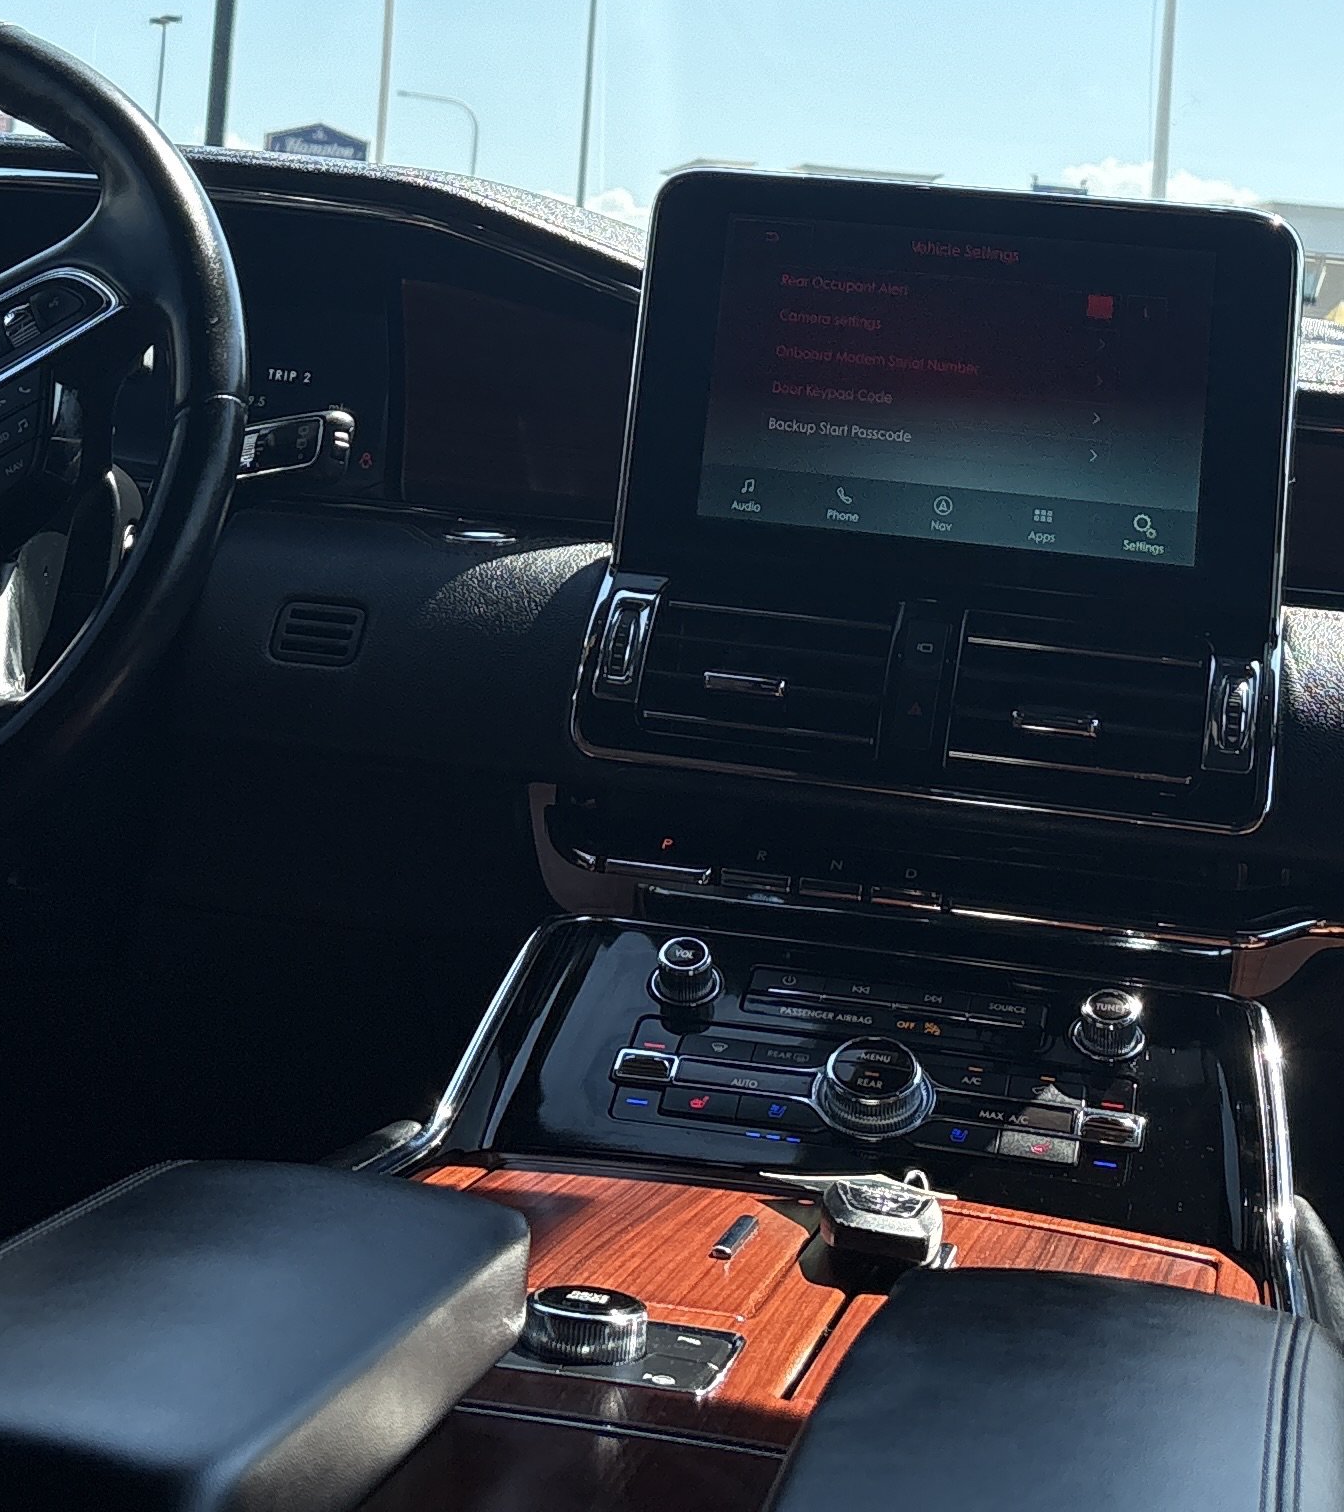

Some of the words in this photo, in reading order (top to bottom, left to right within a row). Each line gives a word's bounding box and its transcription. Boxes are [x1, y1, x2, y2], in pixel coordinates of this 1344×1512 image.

[811, 275, 876, 294] Occupant
[779, 308, 832, 325] Camera
[268, 368, 298, 382] TRIP
[303, 372, 312, 383] 2
[772, 381, 804, 396] Door
[806, 385, 854, 403] Keypad
[858, 389, 893, 404] Code
[768, 417, 816, 435] Backup
[819, 422, 848, 437] Start
[851, 425, 912, 443] Passcode
[6, 459, 24, 475] NAV
[731, 499, 761, 513] Audio
[826, 508, 860, 523] Phone
[930, 519, 953, 532] Nav
[1027, 530, 1056, 545] Apps
[1122, 539, 1165, 556] Settings
[660, 837, 674, 851] P
[756, 850, 768, 862] R
[829, 858, 844, 872] N
[905, 868, 917, 879] D
[675, 946, 695, 960] VOL
[988, 1002, 1027, 1015] SOURCE
[780, 1007, 834, 1021] PASSENGER
[836, 1013, 873, 1026] AIRBAG
[896, 1019, 917, 1031] OFF
[767, 1049, 792, 1060] REAR
[860, 1051, 892, 1064] MENU
[731, 1078, 758, 1089] AUTO
[857, 1077, 883, 1089] REAR
[961, 1076, 982, 1086] A/C
[979, 1109, 1004, 1121] MAX
[1008, 1114, 1029, 1125] A/C
